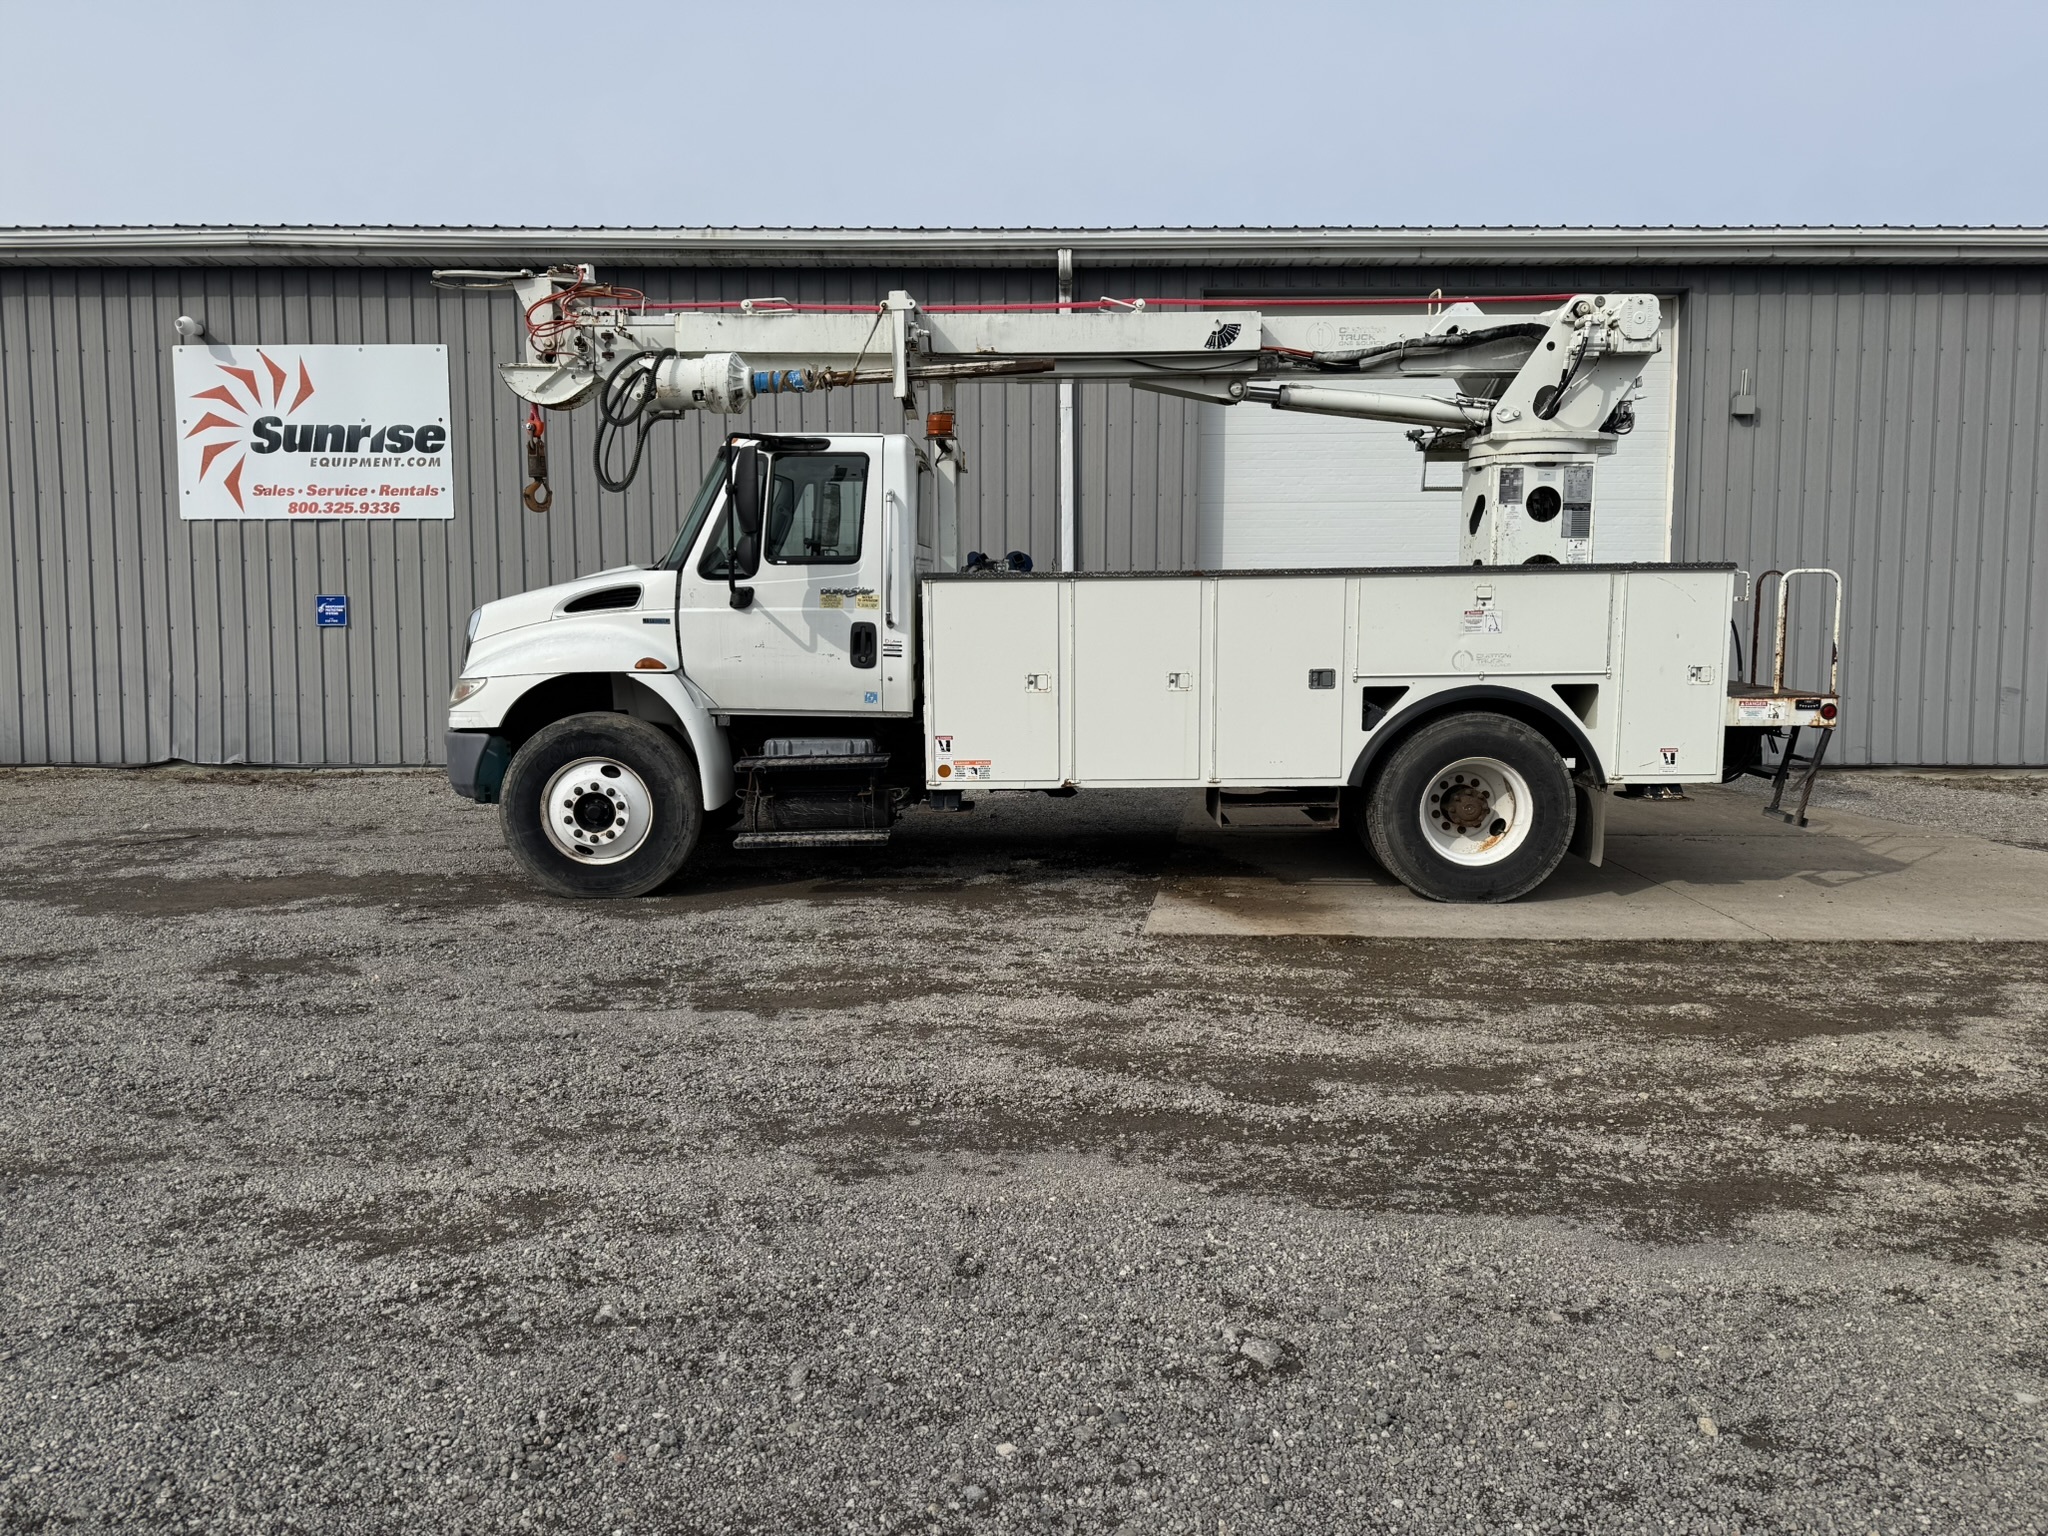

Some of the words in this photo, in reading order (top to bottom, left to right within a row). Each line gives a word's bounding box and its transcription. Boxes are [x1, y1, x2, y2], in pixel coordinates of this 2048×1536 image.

[250, 416, 446, 454] Sunrise
[310, 457, 441, 468] EQUIPMENT.COM
[252, 484, 295, 496] Sales
[306, 484, 368, 496] Service
[378, 484, 439, 496] Rentals
[288, 502, 400, 514] 800.325.9336
